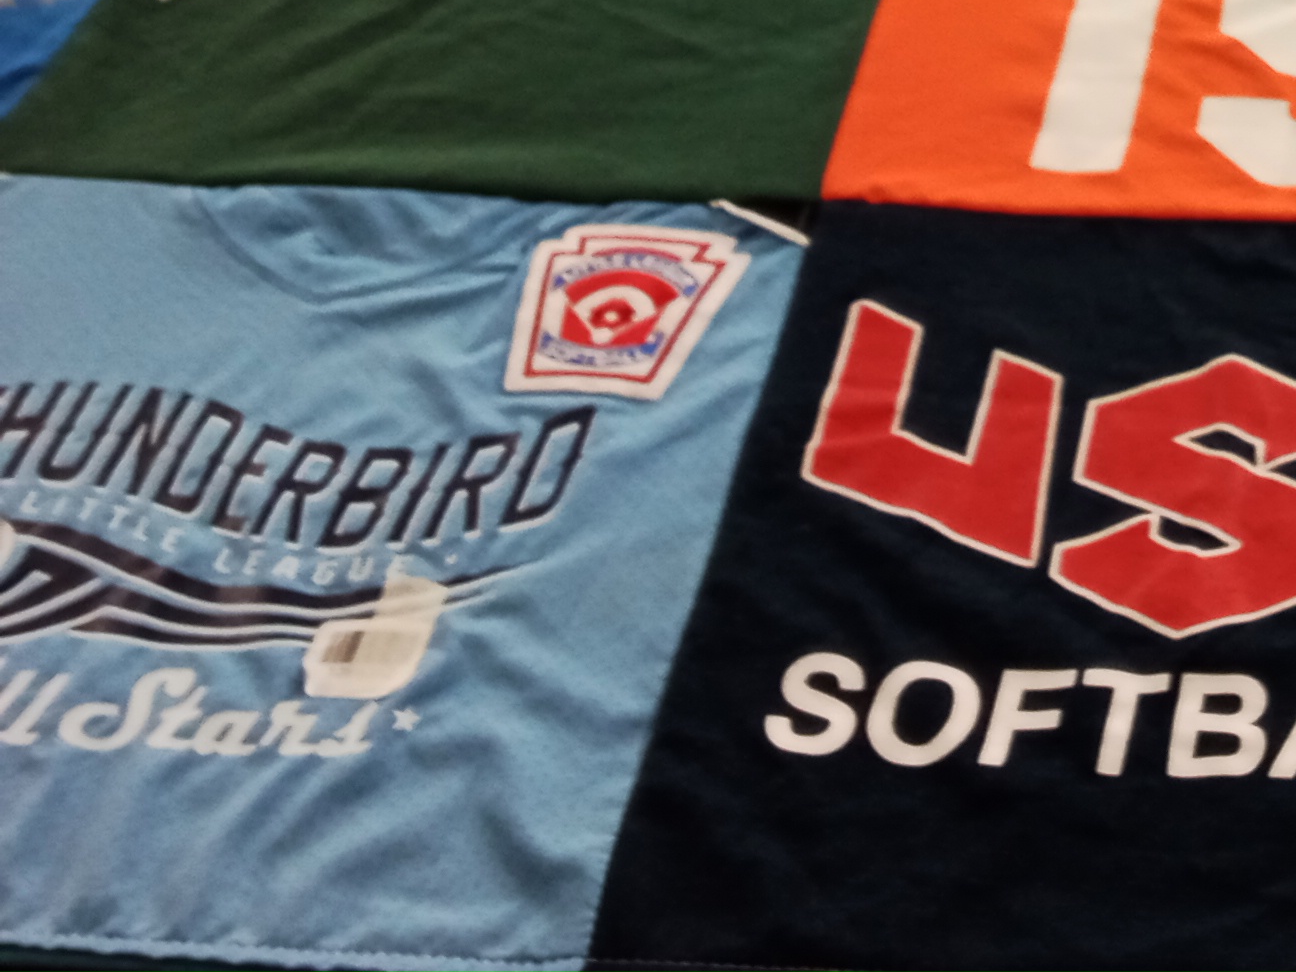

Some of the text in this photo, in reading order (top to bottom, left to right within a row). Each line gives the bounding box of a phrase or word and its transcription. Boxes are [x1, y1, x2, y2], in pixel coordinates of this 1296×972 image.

[0, 381, 597, 549] HUNDERBIRD
[19, 490, 184, 554] LITTLE
[0, 656, 380, 758] ll Stars
